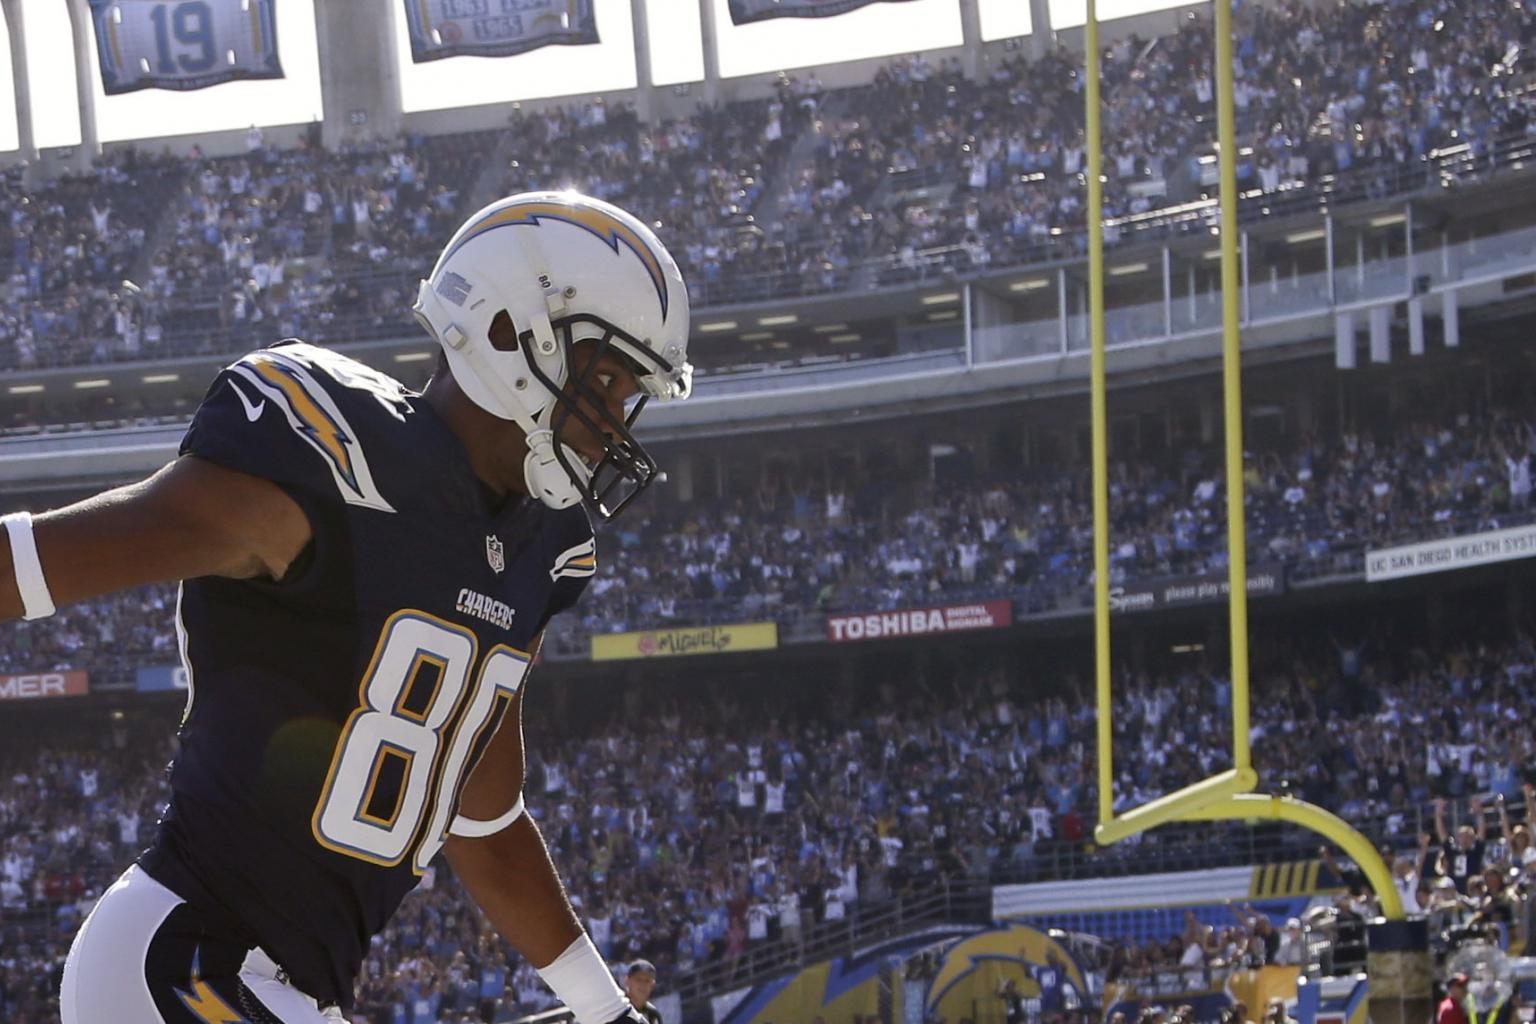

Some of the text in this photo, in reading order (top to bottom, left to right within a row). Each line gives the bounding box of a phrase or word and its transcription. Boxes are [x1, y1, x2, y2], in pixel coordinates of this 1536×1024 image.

[149, 1, 216, 73] 19
[538, 275, 552, 288] 80
[1418, 547, 1452, 566] DIEGO
[1198, 581, 1219, 598] play
[455, 588, 516, 631] CHARGERS
[830, 609, 946, 641] TOSHIBA
[312, 608, 531, 876] 80
